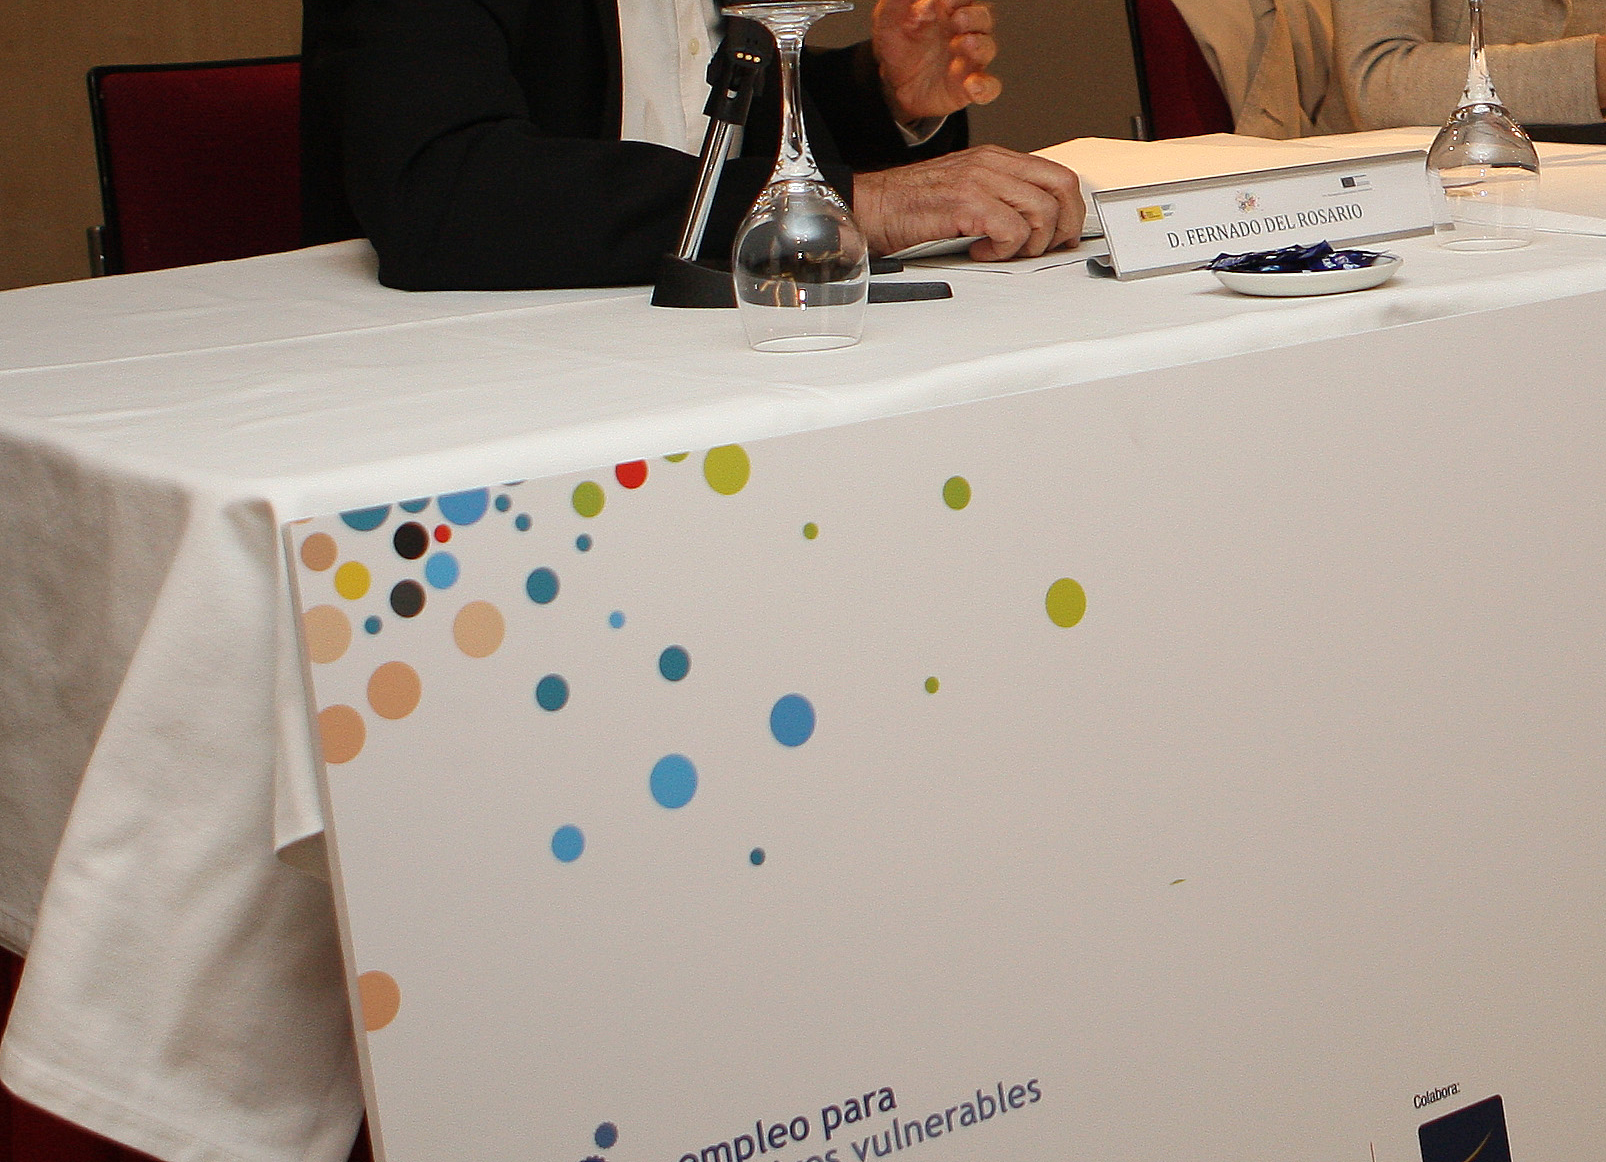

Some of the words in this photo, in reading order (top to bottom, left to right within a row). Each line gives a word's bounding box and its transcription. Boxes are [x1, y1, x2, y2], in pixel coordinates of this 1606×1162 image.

[1167, 231, 1185, 249] D.
[1187, 220, 1261, 246] FERNADO
[1264, 213, 1295, 234] DEL
[1297, 202, 1363, 229] ROSARIO
[821, 1086, 897, 1141] para
[851, 1077, 1043, 1161] vulnerables
[1413, 1082, 1461, 1109] Colabora:
